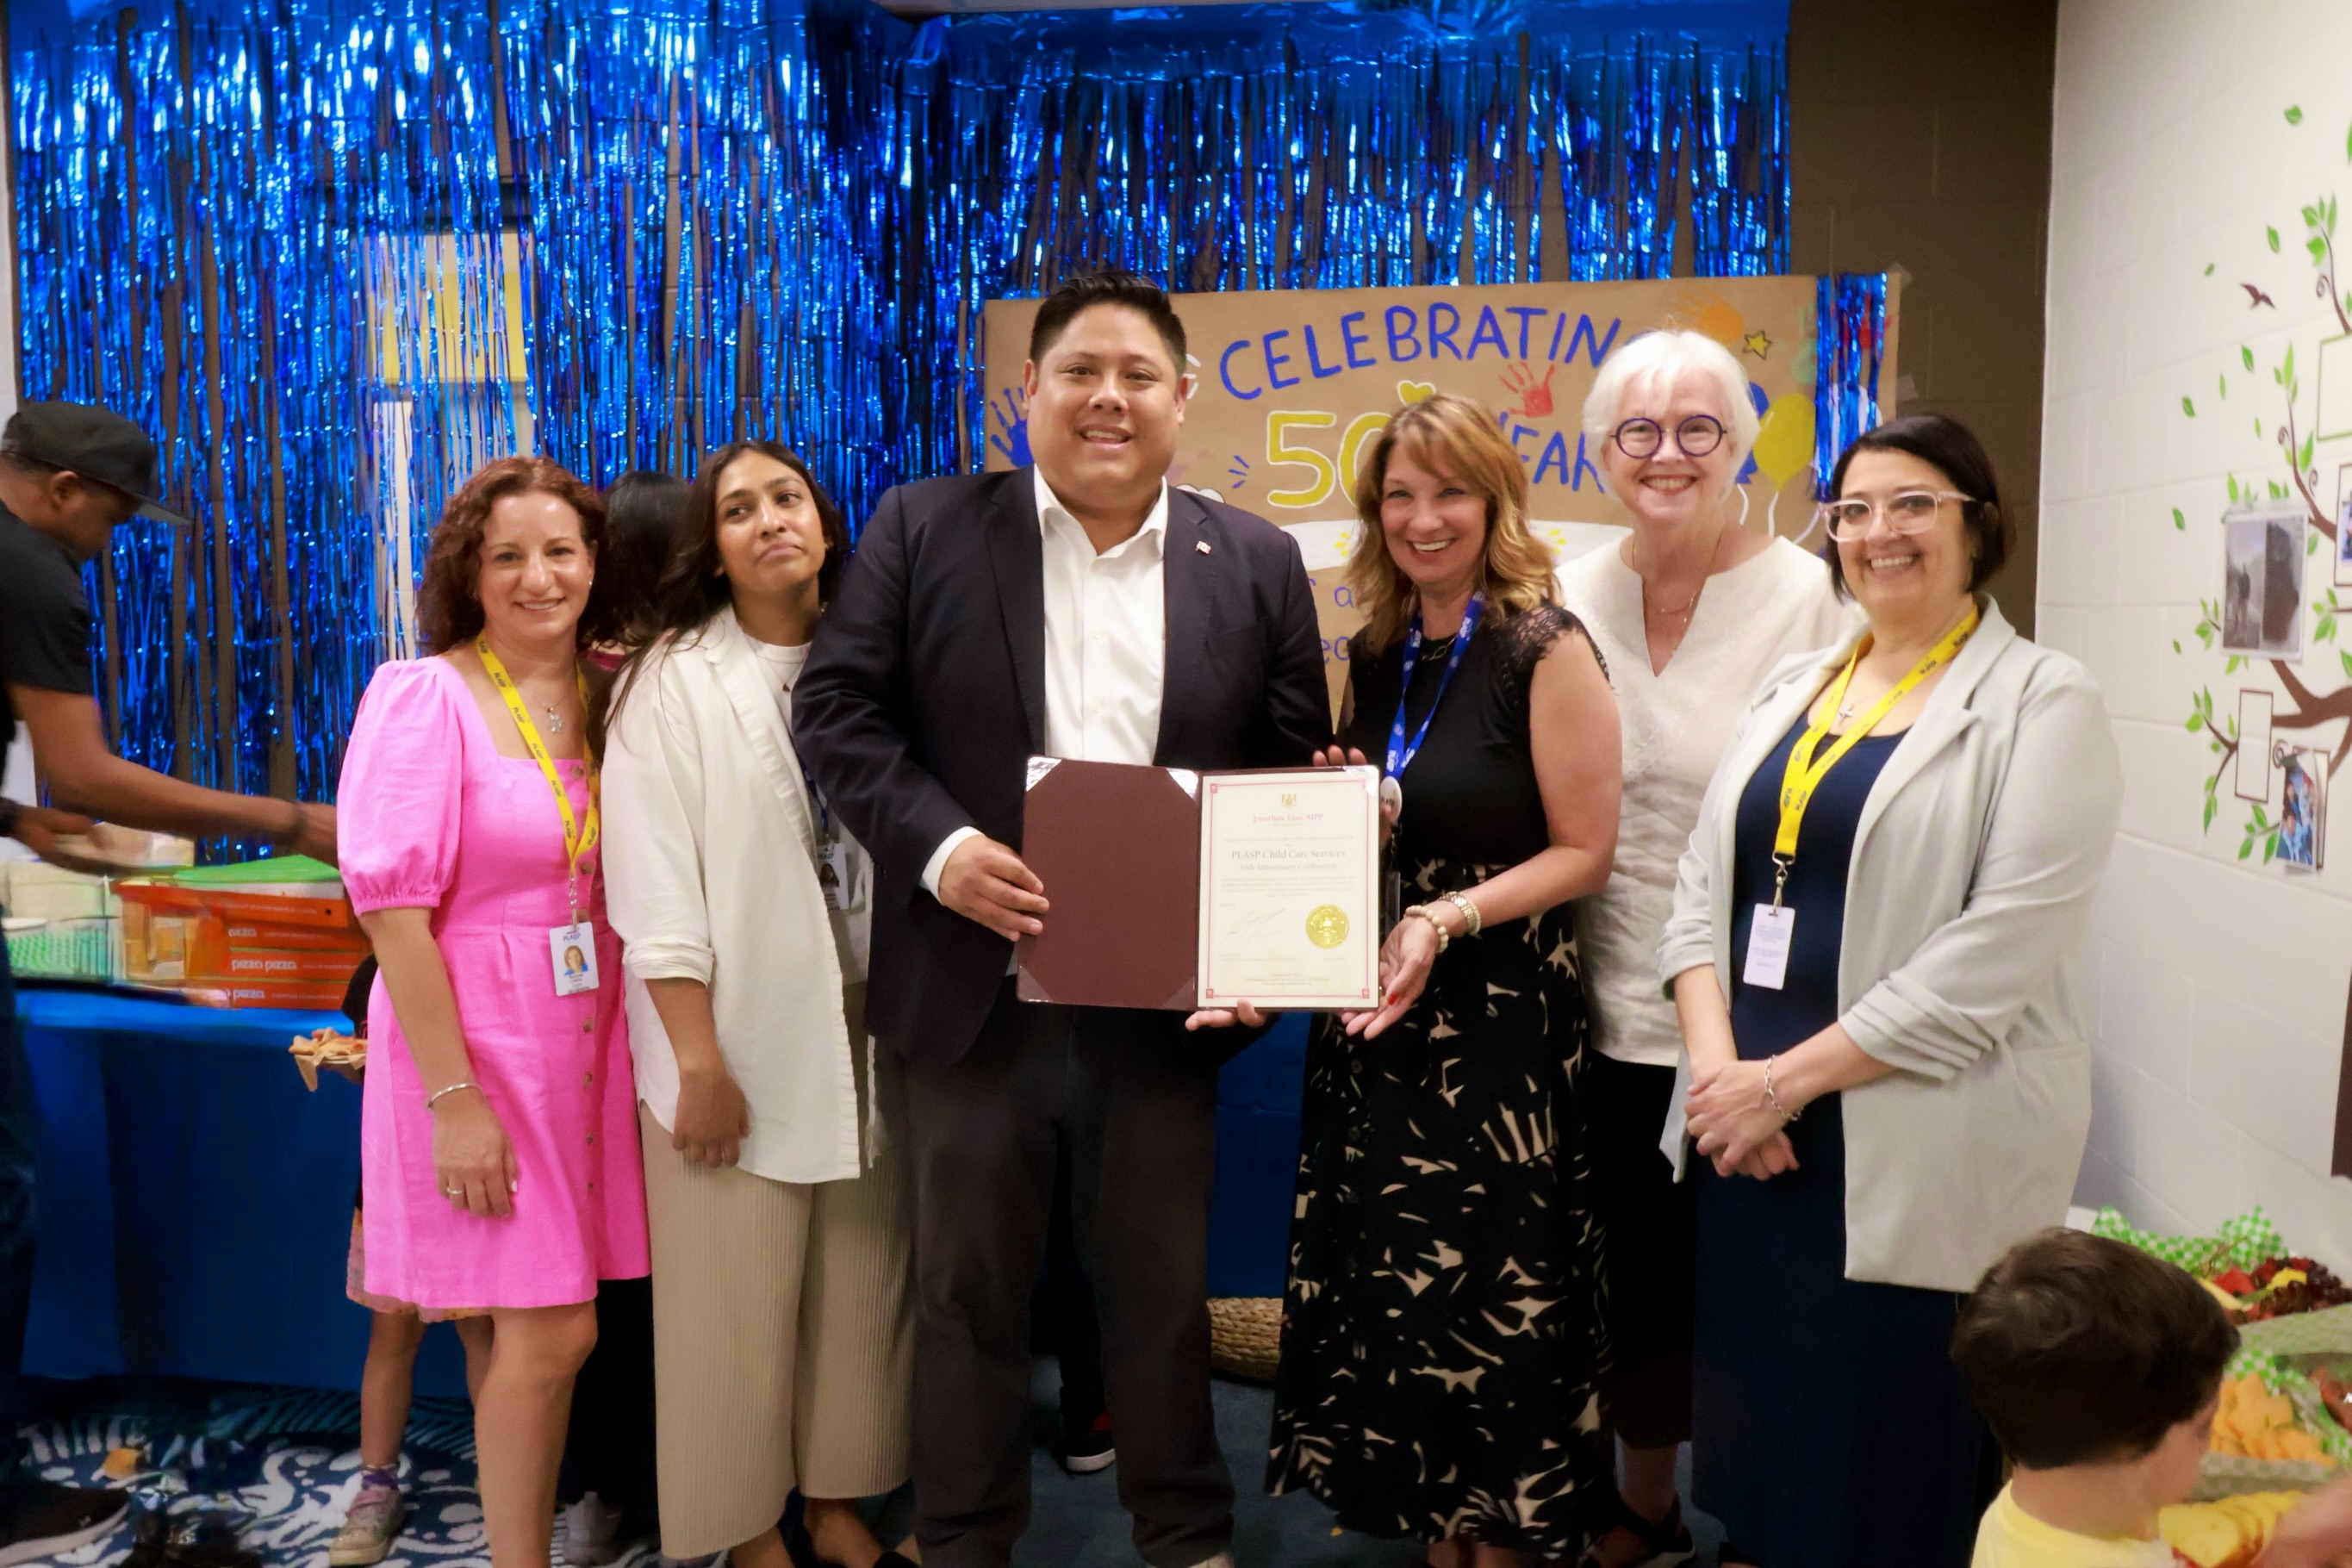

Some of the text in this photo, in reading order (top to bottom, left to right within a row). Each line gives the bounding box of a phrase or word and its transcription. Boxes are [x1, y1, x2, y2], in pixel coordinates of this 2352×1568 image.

[1219, 302, 1654, 401] CELEBRATIN
[1231, 849, 1346, 860] PLASP Child Care Services
[232, 959, 263, 972] pizza
[264, 960, 297, 973] pizza
[233, 989, 265, 1000] pizza
